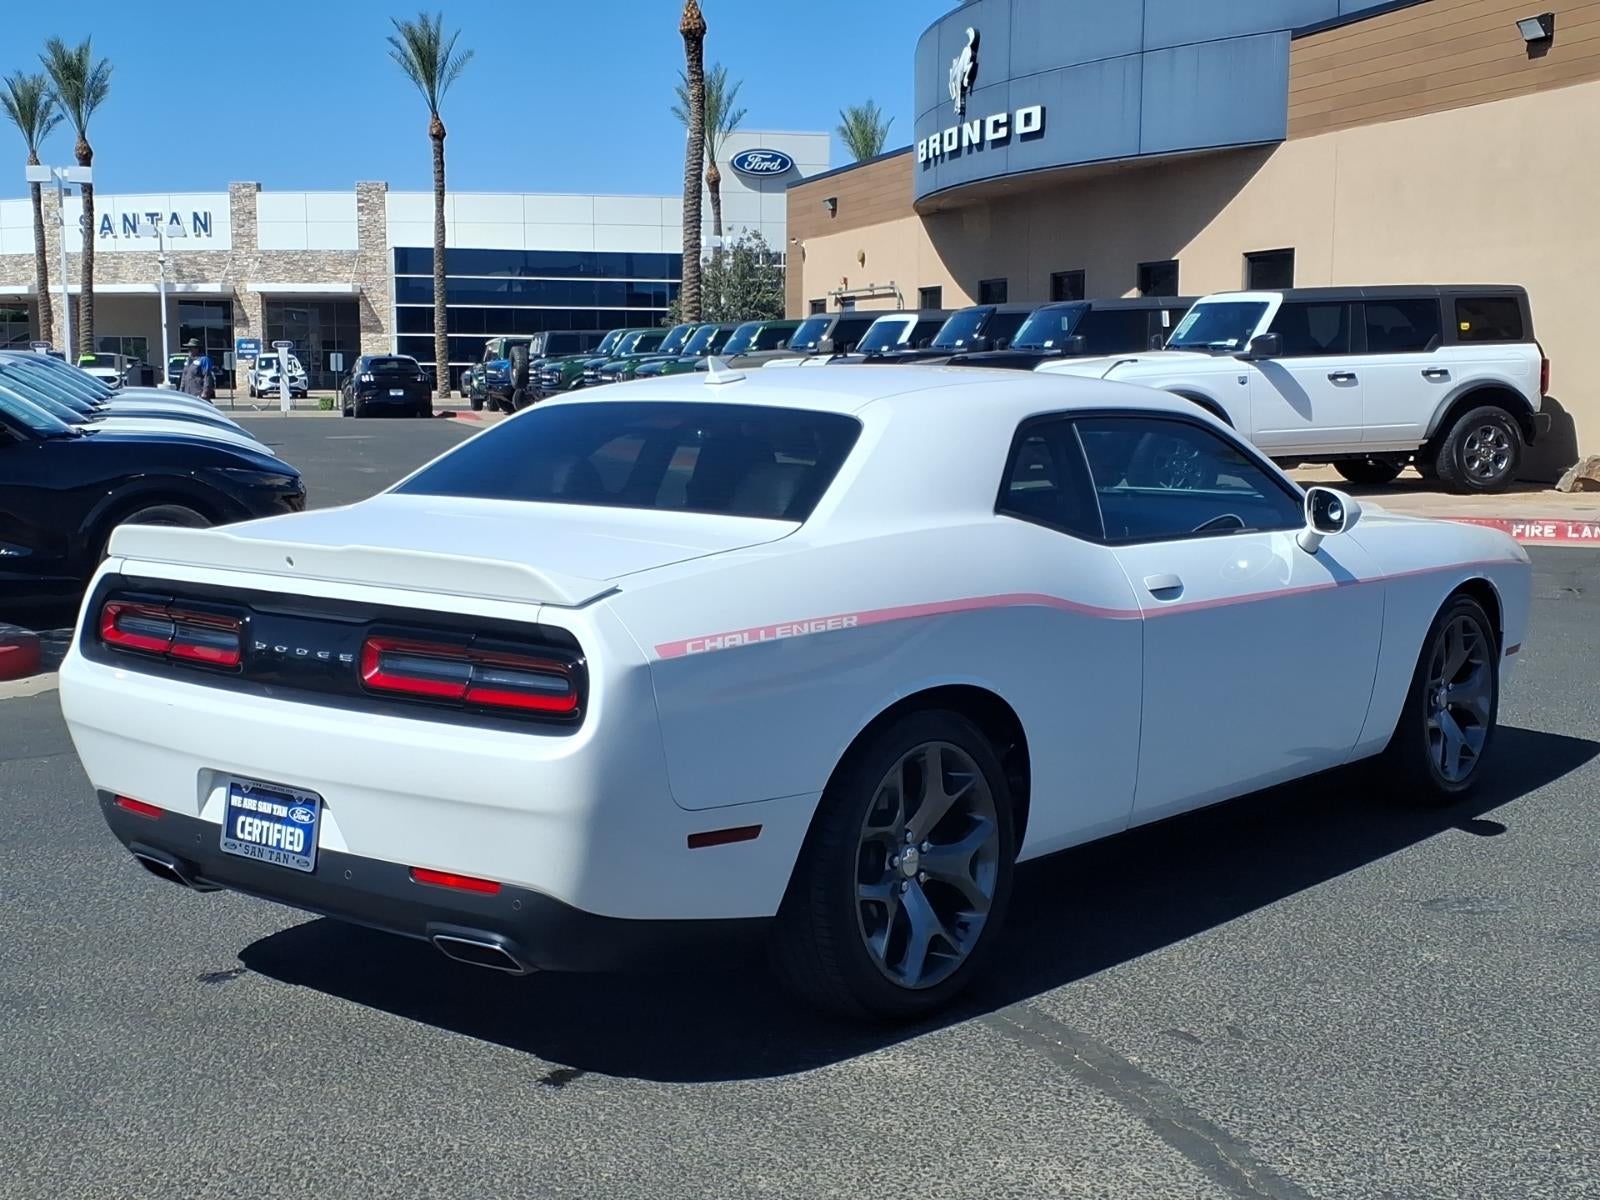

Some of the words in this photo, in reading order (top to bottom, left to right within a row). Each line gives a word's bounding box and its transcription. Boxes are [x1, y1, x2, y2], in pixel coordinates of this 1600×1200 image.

[917, 104, 1043, 163] BRONCO
[743, 152, 783, 171] Ford
[1512, 524, 1556, 538] FIRE
[686, 615, 858, 655] CHALLENGER
[255, 641, 353, 662] DODGE
[243, 797, 257, 811] ARE
[258, 800, 272, 814] SAN
[272, 804, 288, 817] TAN
[236, 816, 304, 852] CERTIFIED
[243, 845, 264, 858] SAN
[268, 850, 289, 864] TAN
